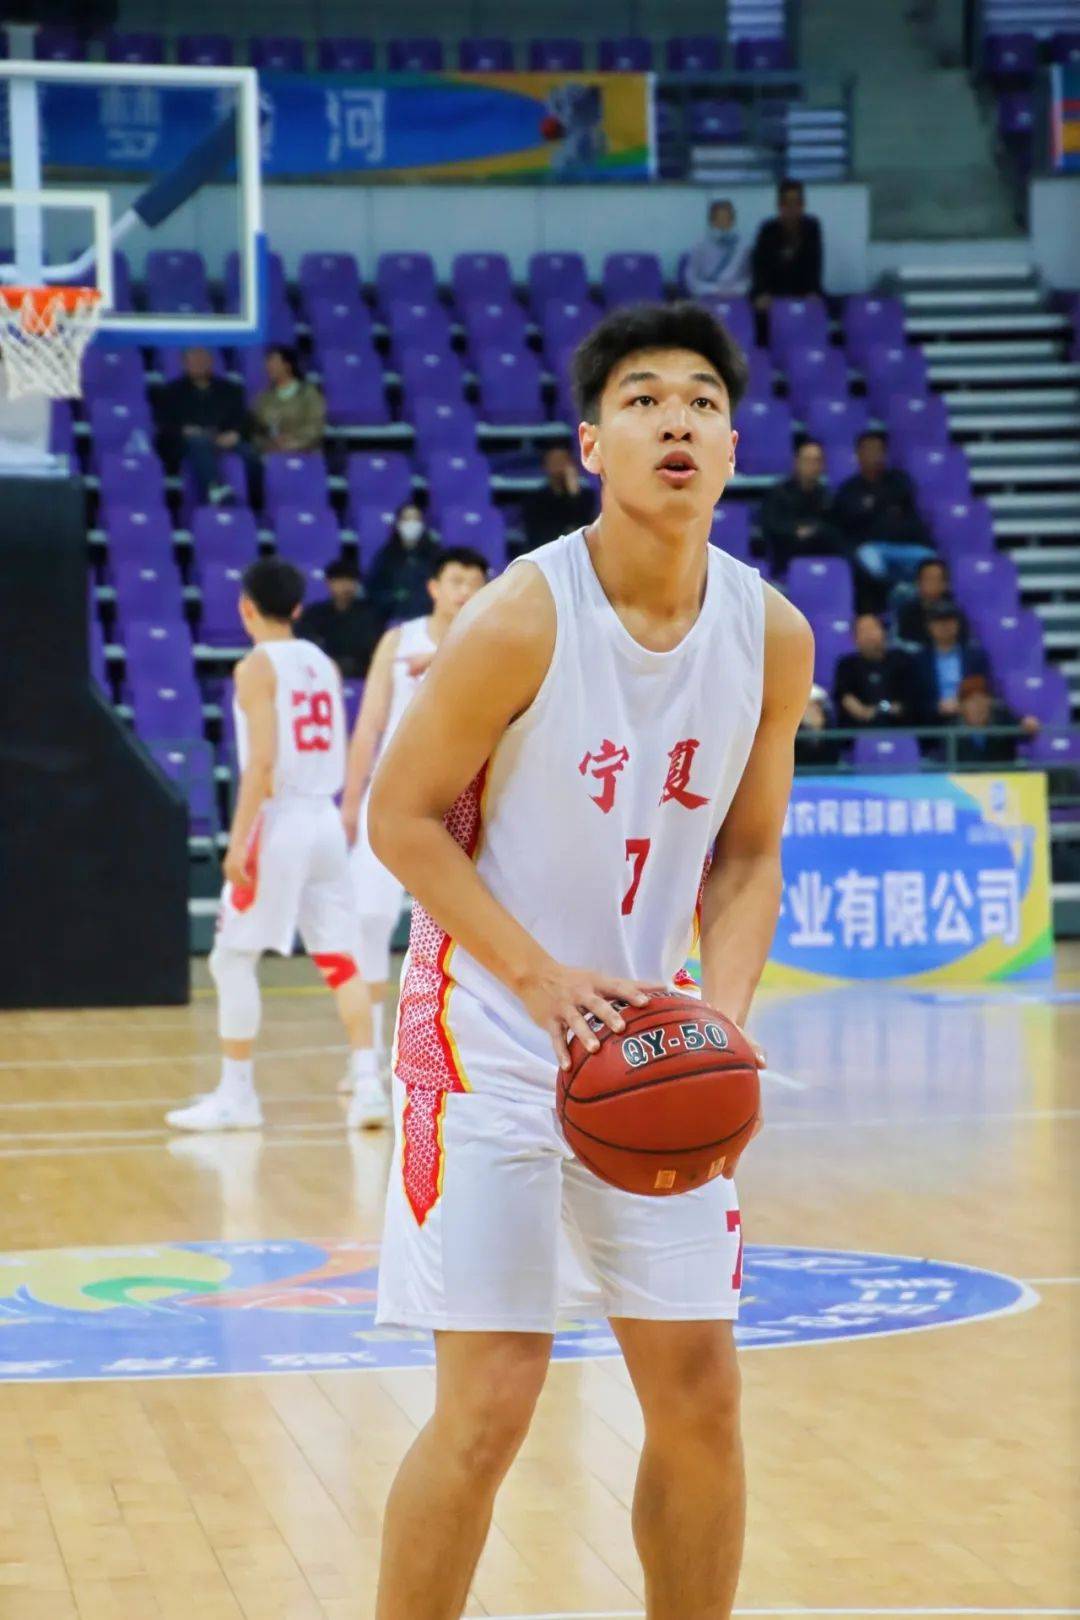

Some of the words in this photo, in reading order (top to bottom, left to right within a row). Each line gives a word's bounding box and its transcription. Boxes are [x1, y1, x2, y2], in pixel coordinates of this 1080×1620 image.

[578, 738, 711, 814] 宁夏
[621, 838, 651, 915] 7
[780, 868, 1022, 947] 业有限公司
[622, 1023, 728, 1067] QY-50
